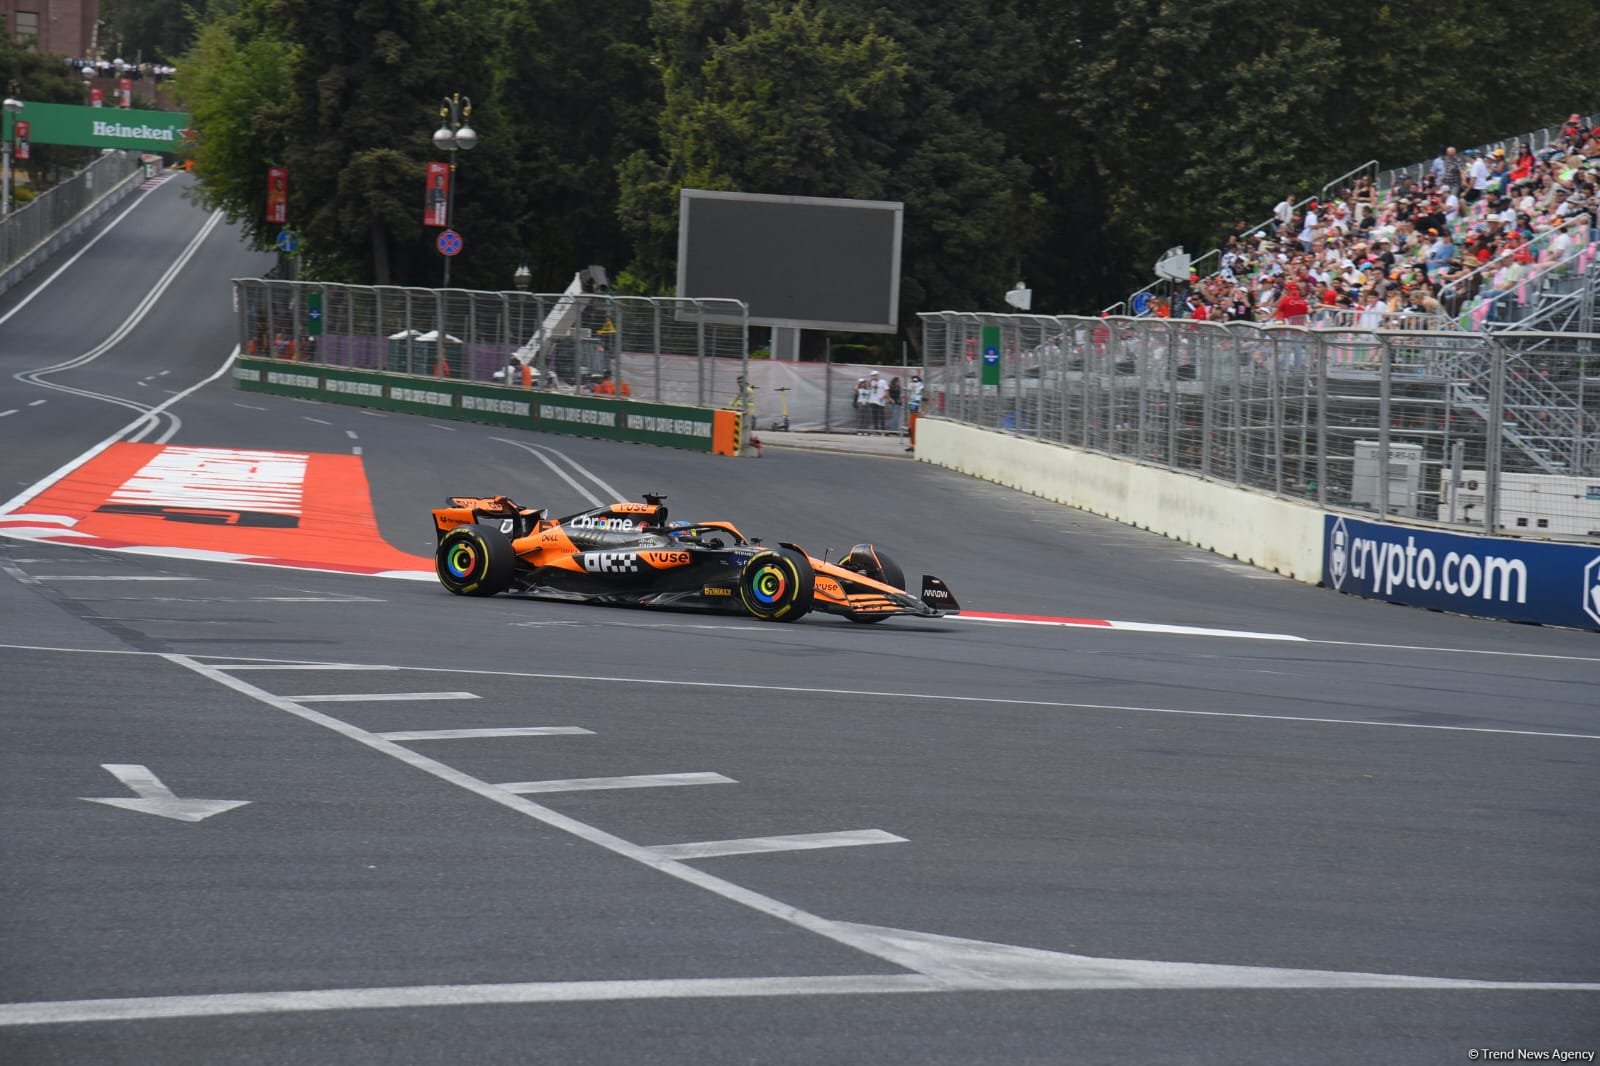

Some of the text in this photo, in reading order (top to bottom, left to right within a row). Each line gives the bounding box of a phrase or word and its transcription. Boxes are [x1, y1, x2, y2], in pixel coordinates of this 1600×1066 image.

[93, 121, 173, 140] Heineken
[571, 514, 633, 531] Chrome
[1351, 536, 1527, 603] crypto.com
